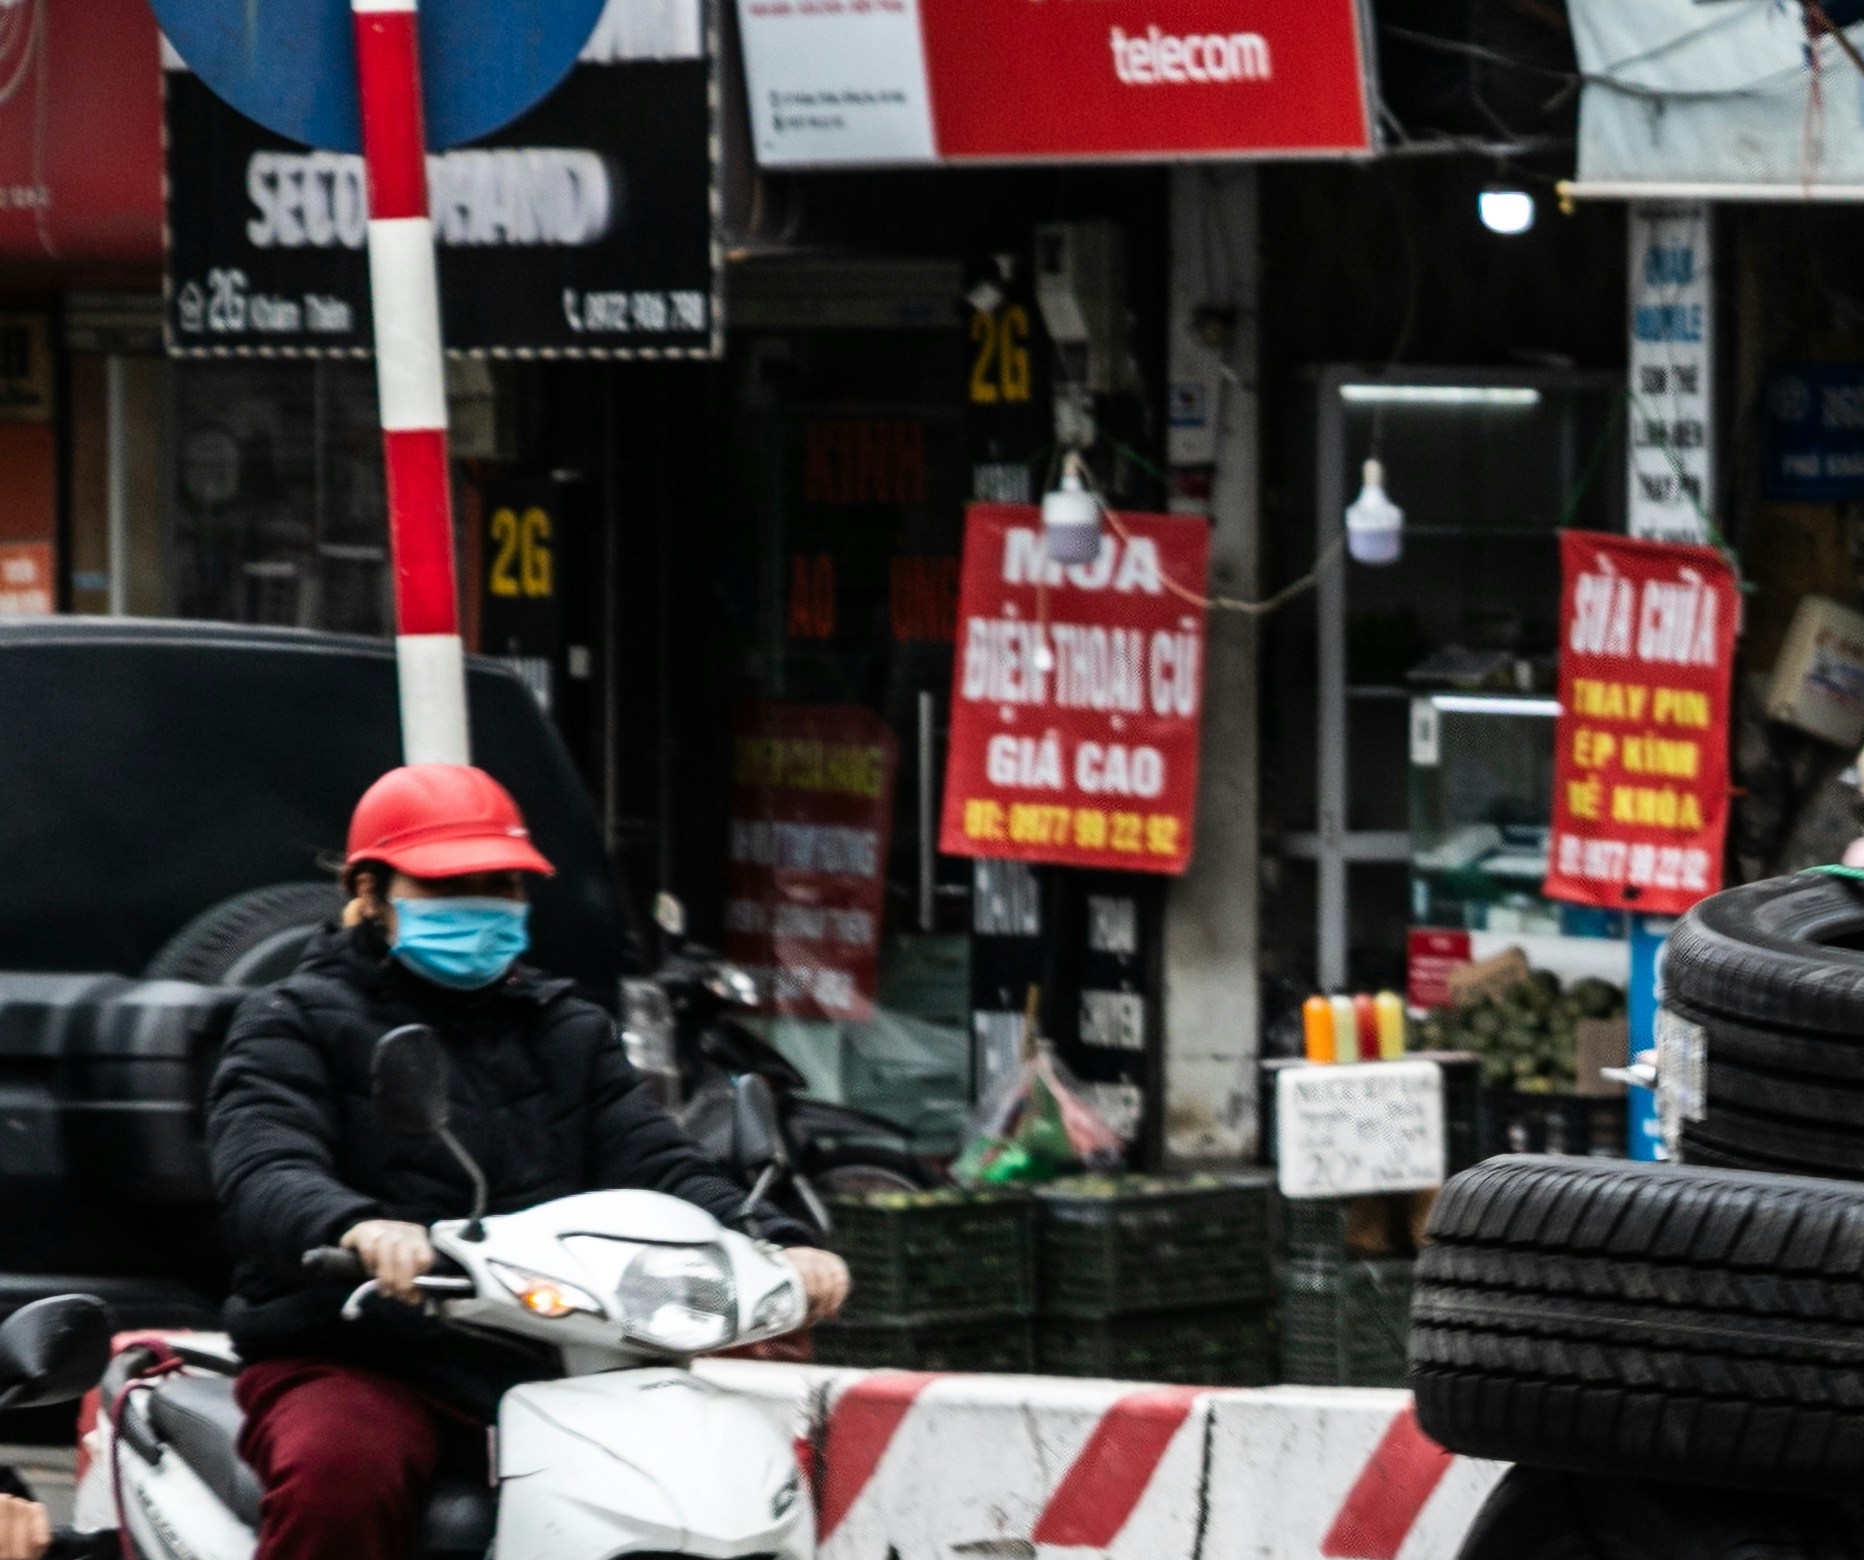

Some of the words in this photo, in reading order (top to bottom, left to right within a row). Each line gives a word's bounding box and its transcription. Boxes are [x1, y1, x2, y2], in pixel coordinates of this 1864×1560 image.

[1109, 24, 1273, 85] telecom
[985, 727, 1064, 792] GIÁ
[1074, 738, 1165, 800] CAO
